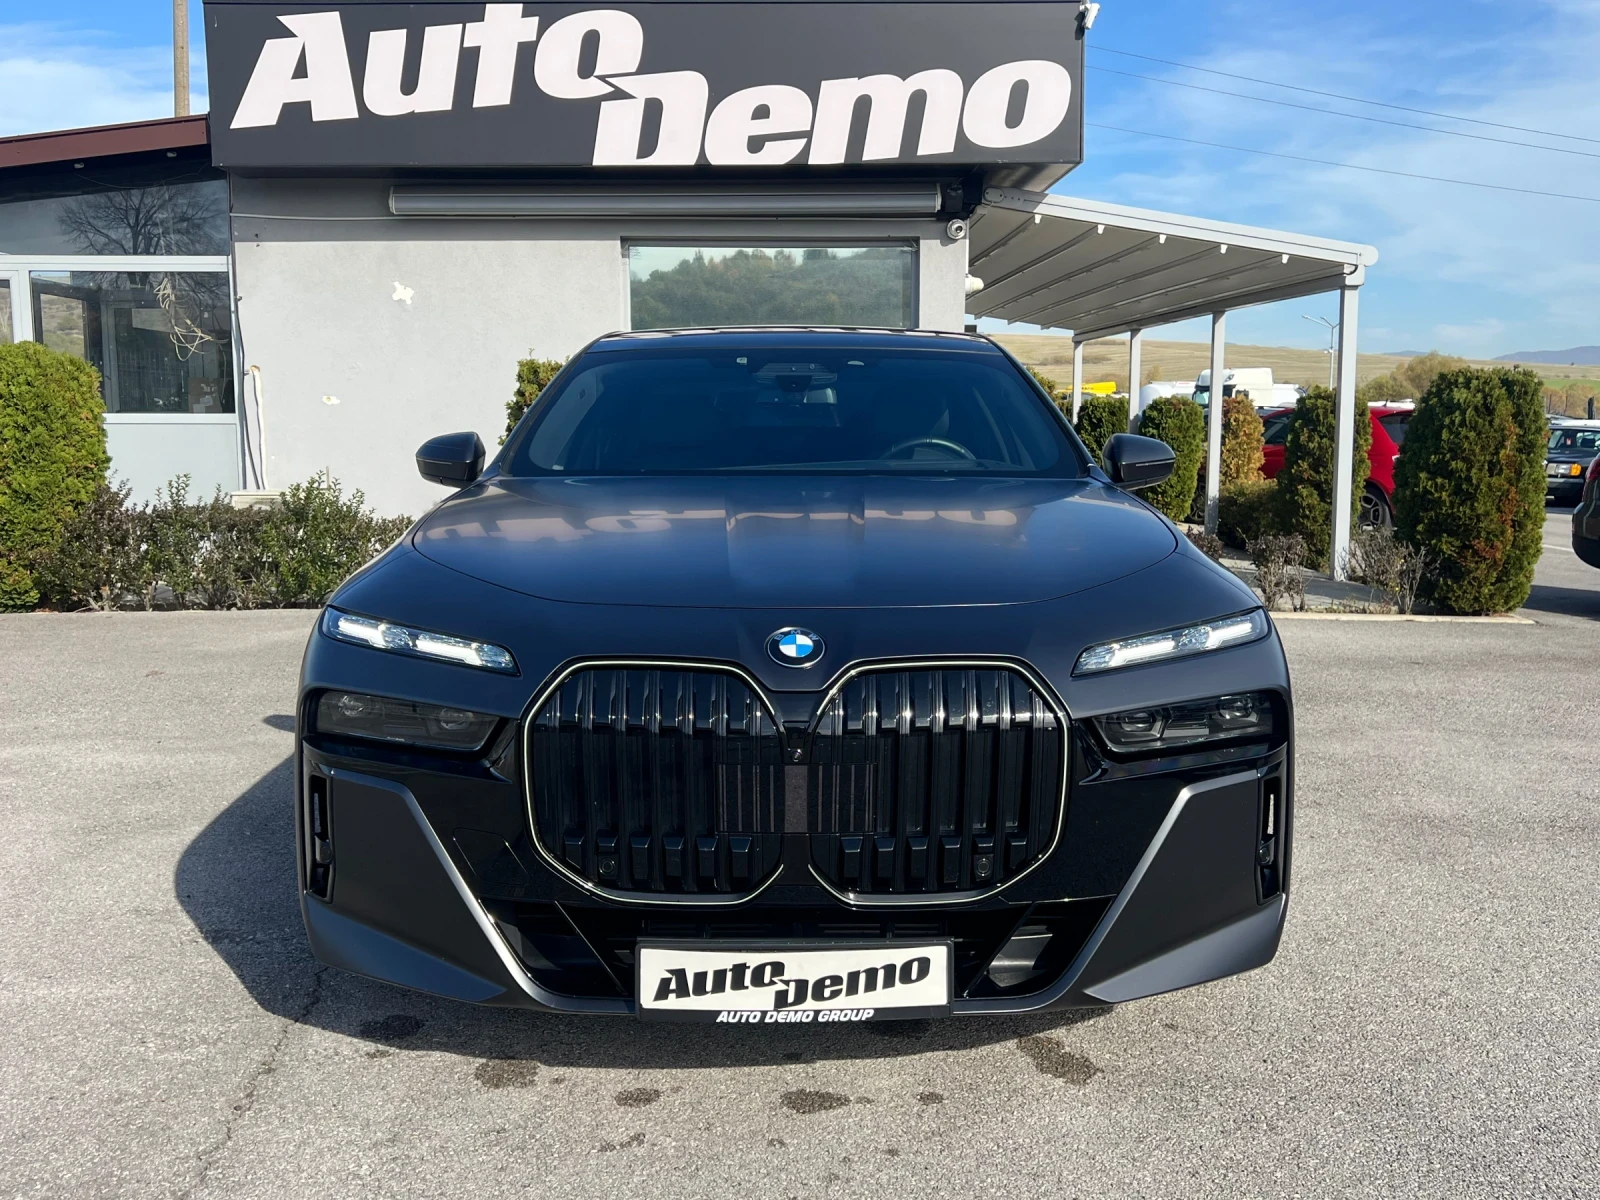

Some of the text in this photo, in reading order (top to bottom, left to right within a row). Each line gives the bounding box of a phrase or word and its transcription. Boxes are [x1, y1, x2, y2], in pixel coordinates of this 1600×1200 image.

[230, 2, 1073, 167] Auto Demo
[774, 630, 819, 640] BMW
[653, 956, 931, 1010] Auto Demo
[716, 1009, 875, 1023] AUTO DEMO GROUP
